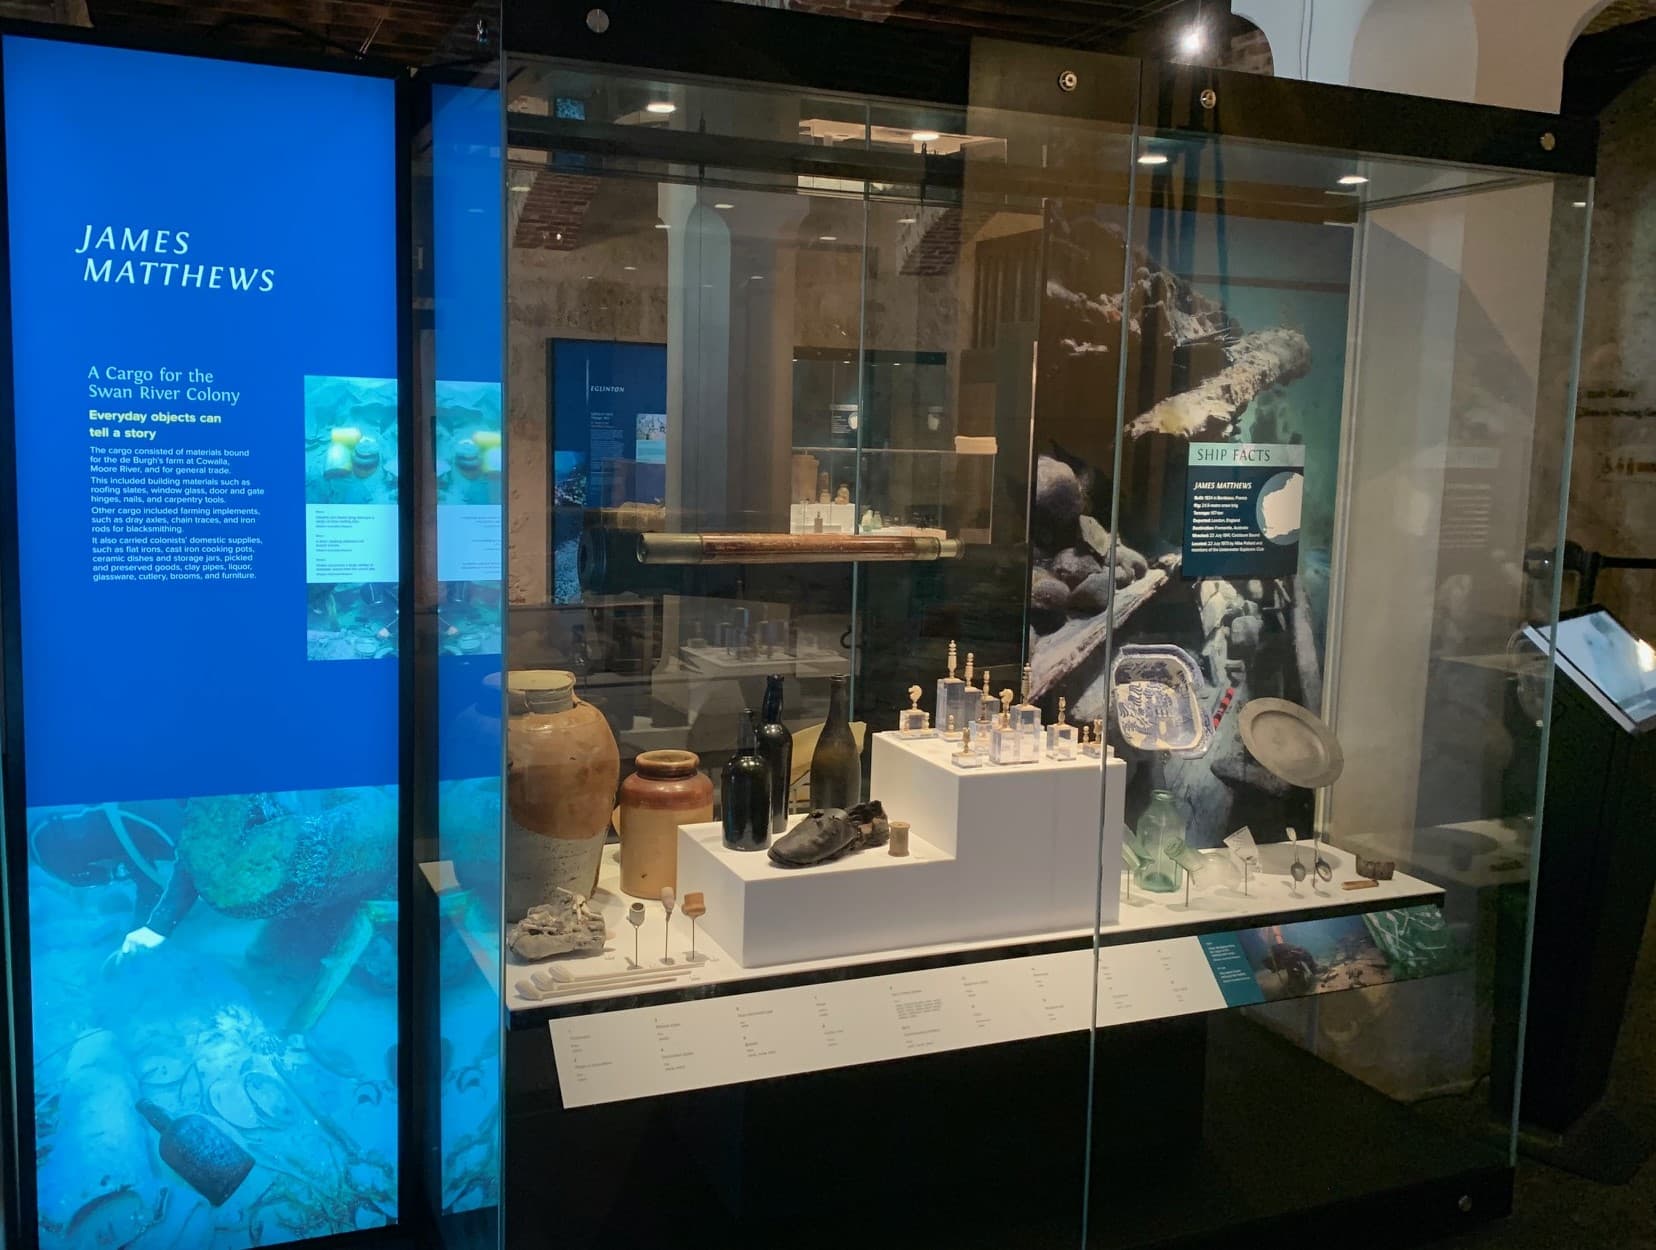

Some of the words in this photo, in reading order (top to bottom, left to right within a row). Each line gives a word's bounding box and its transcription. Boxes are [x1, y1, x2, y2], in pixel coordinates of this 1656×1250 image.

[75, 225, 190, 255] JAMES
[84, 258, 275, 292] MATTHEWS
[88, 366, 99, 380] A
[106, 367, 153, 384] Cargo
[160, 368, 182, 382] for
[189, 369, 213, 383] the
[89, 385, 132, 398] Swan
[140, 387, 180, 400] River
[187, 387, 240, 406] Colony
[89, 410, 147, 423] Everyday
[151, 412, 196, 425] objects
[200, 414, 221, 423] can
[89, 428, 108, 438] tell
[125, 429, 156, 440] story
[1198, 449, 1228, 460] SHIP
[1233, 449, 1271, 461] FACTS
[148, 477, 180, 486] building
[1194, 482, 1215, 490] JAMES
[91, 486, 120, 494] roofing
[91, 495, 121, 504] hinges,
[181, 507, 210, 516] farming
[126, 516, 143, 524] dray
[202, 546, 233, 554] cooking
[155, 564, 182, 572] goods,
[203, 564, 226, 572] pipes,
[229, 563, 252, 571] liquor,
[93, 573, 136, 582] glassware,
[139, 573, 167, 581] cutlery,
